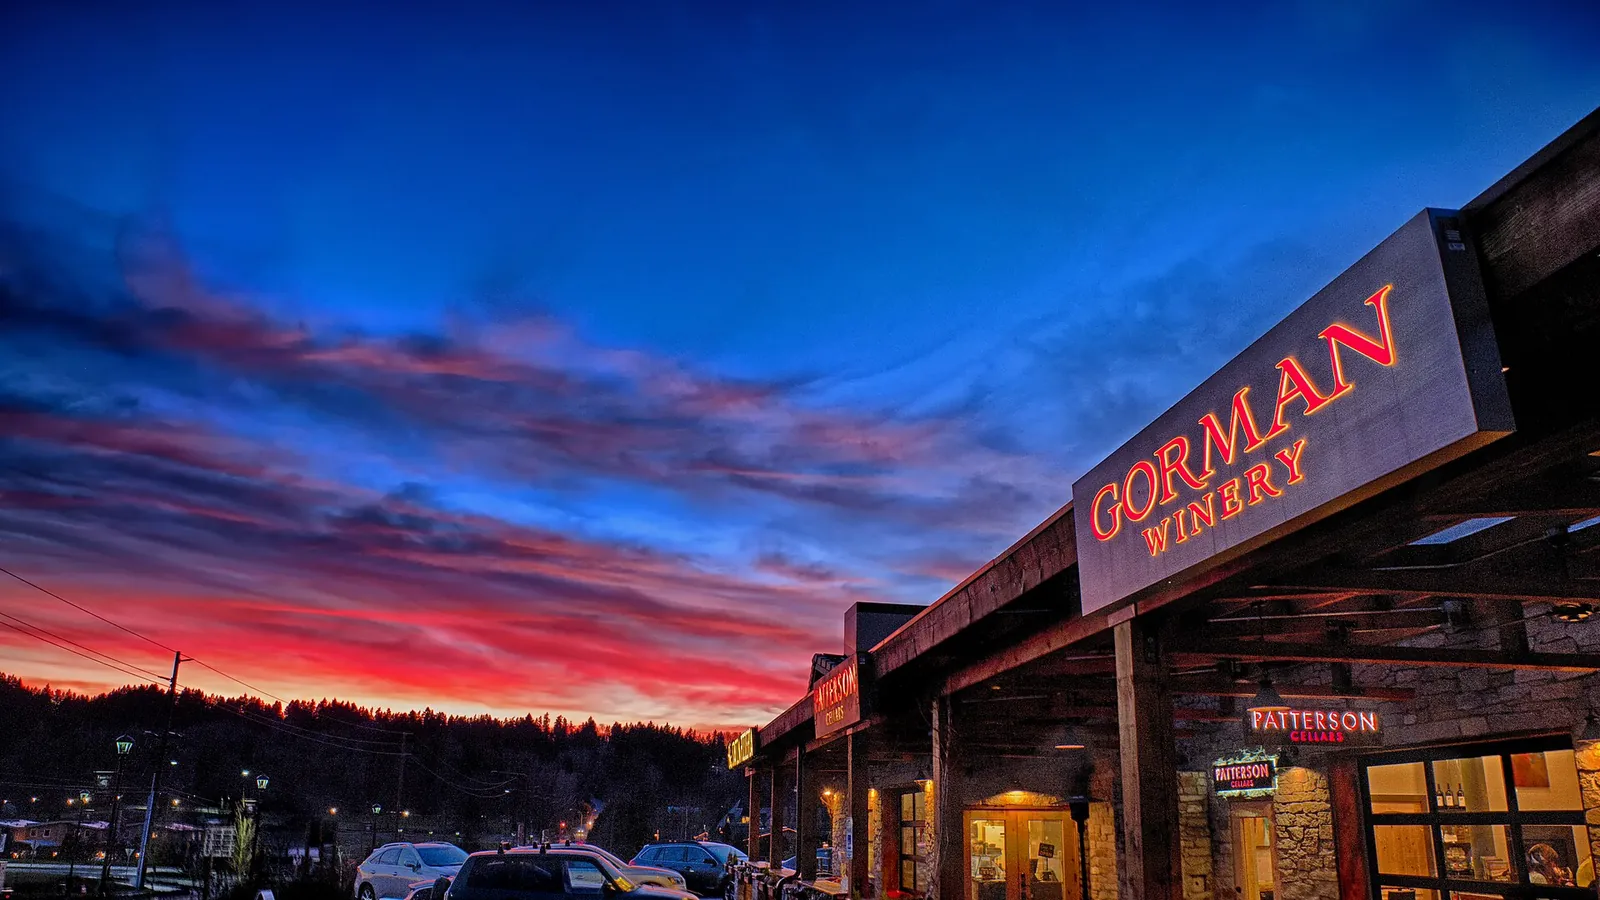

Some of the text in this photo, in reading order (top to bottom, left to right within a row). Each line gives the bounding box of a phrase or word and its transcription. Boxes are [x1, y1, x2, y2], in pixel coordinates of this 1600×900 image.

[1089, 284, 1397, 541] GORMAN
[1141, 439, 1306, 556] WINERY
[1251, 710, 1378, 731] PATTERSON
[1289, 731, 1344, 742] CELLARS
[1215, 763, 1269, 781] PATTERSON
[1230, 779, 1254, 788] CELLARS
